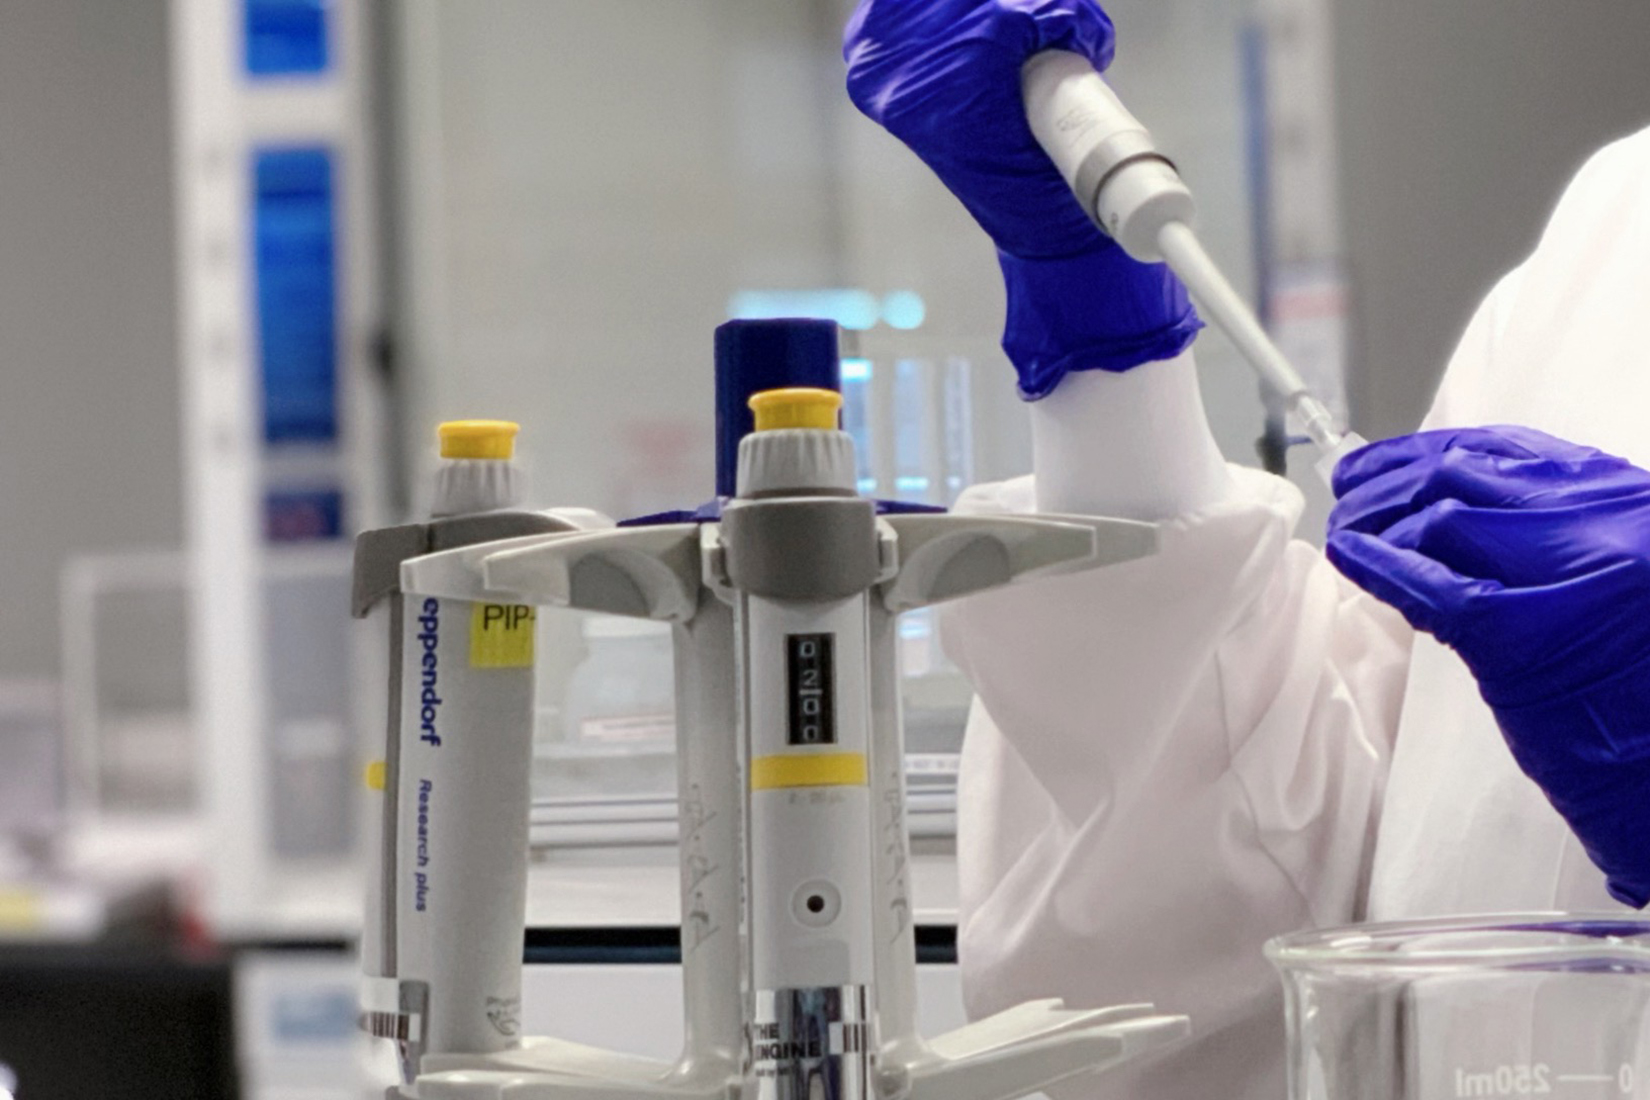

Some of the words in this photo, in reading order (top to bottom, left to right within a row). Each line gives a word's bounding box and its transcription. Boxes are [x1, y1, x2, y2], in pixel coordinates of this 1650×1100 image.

[417, 597, 442, 747] eppendorf
[417, 778, 432, 867] Research
[413, 870, 428, 912] plus
